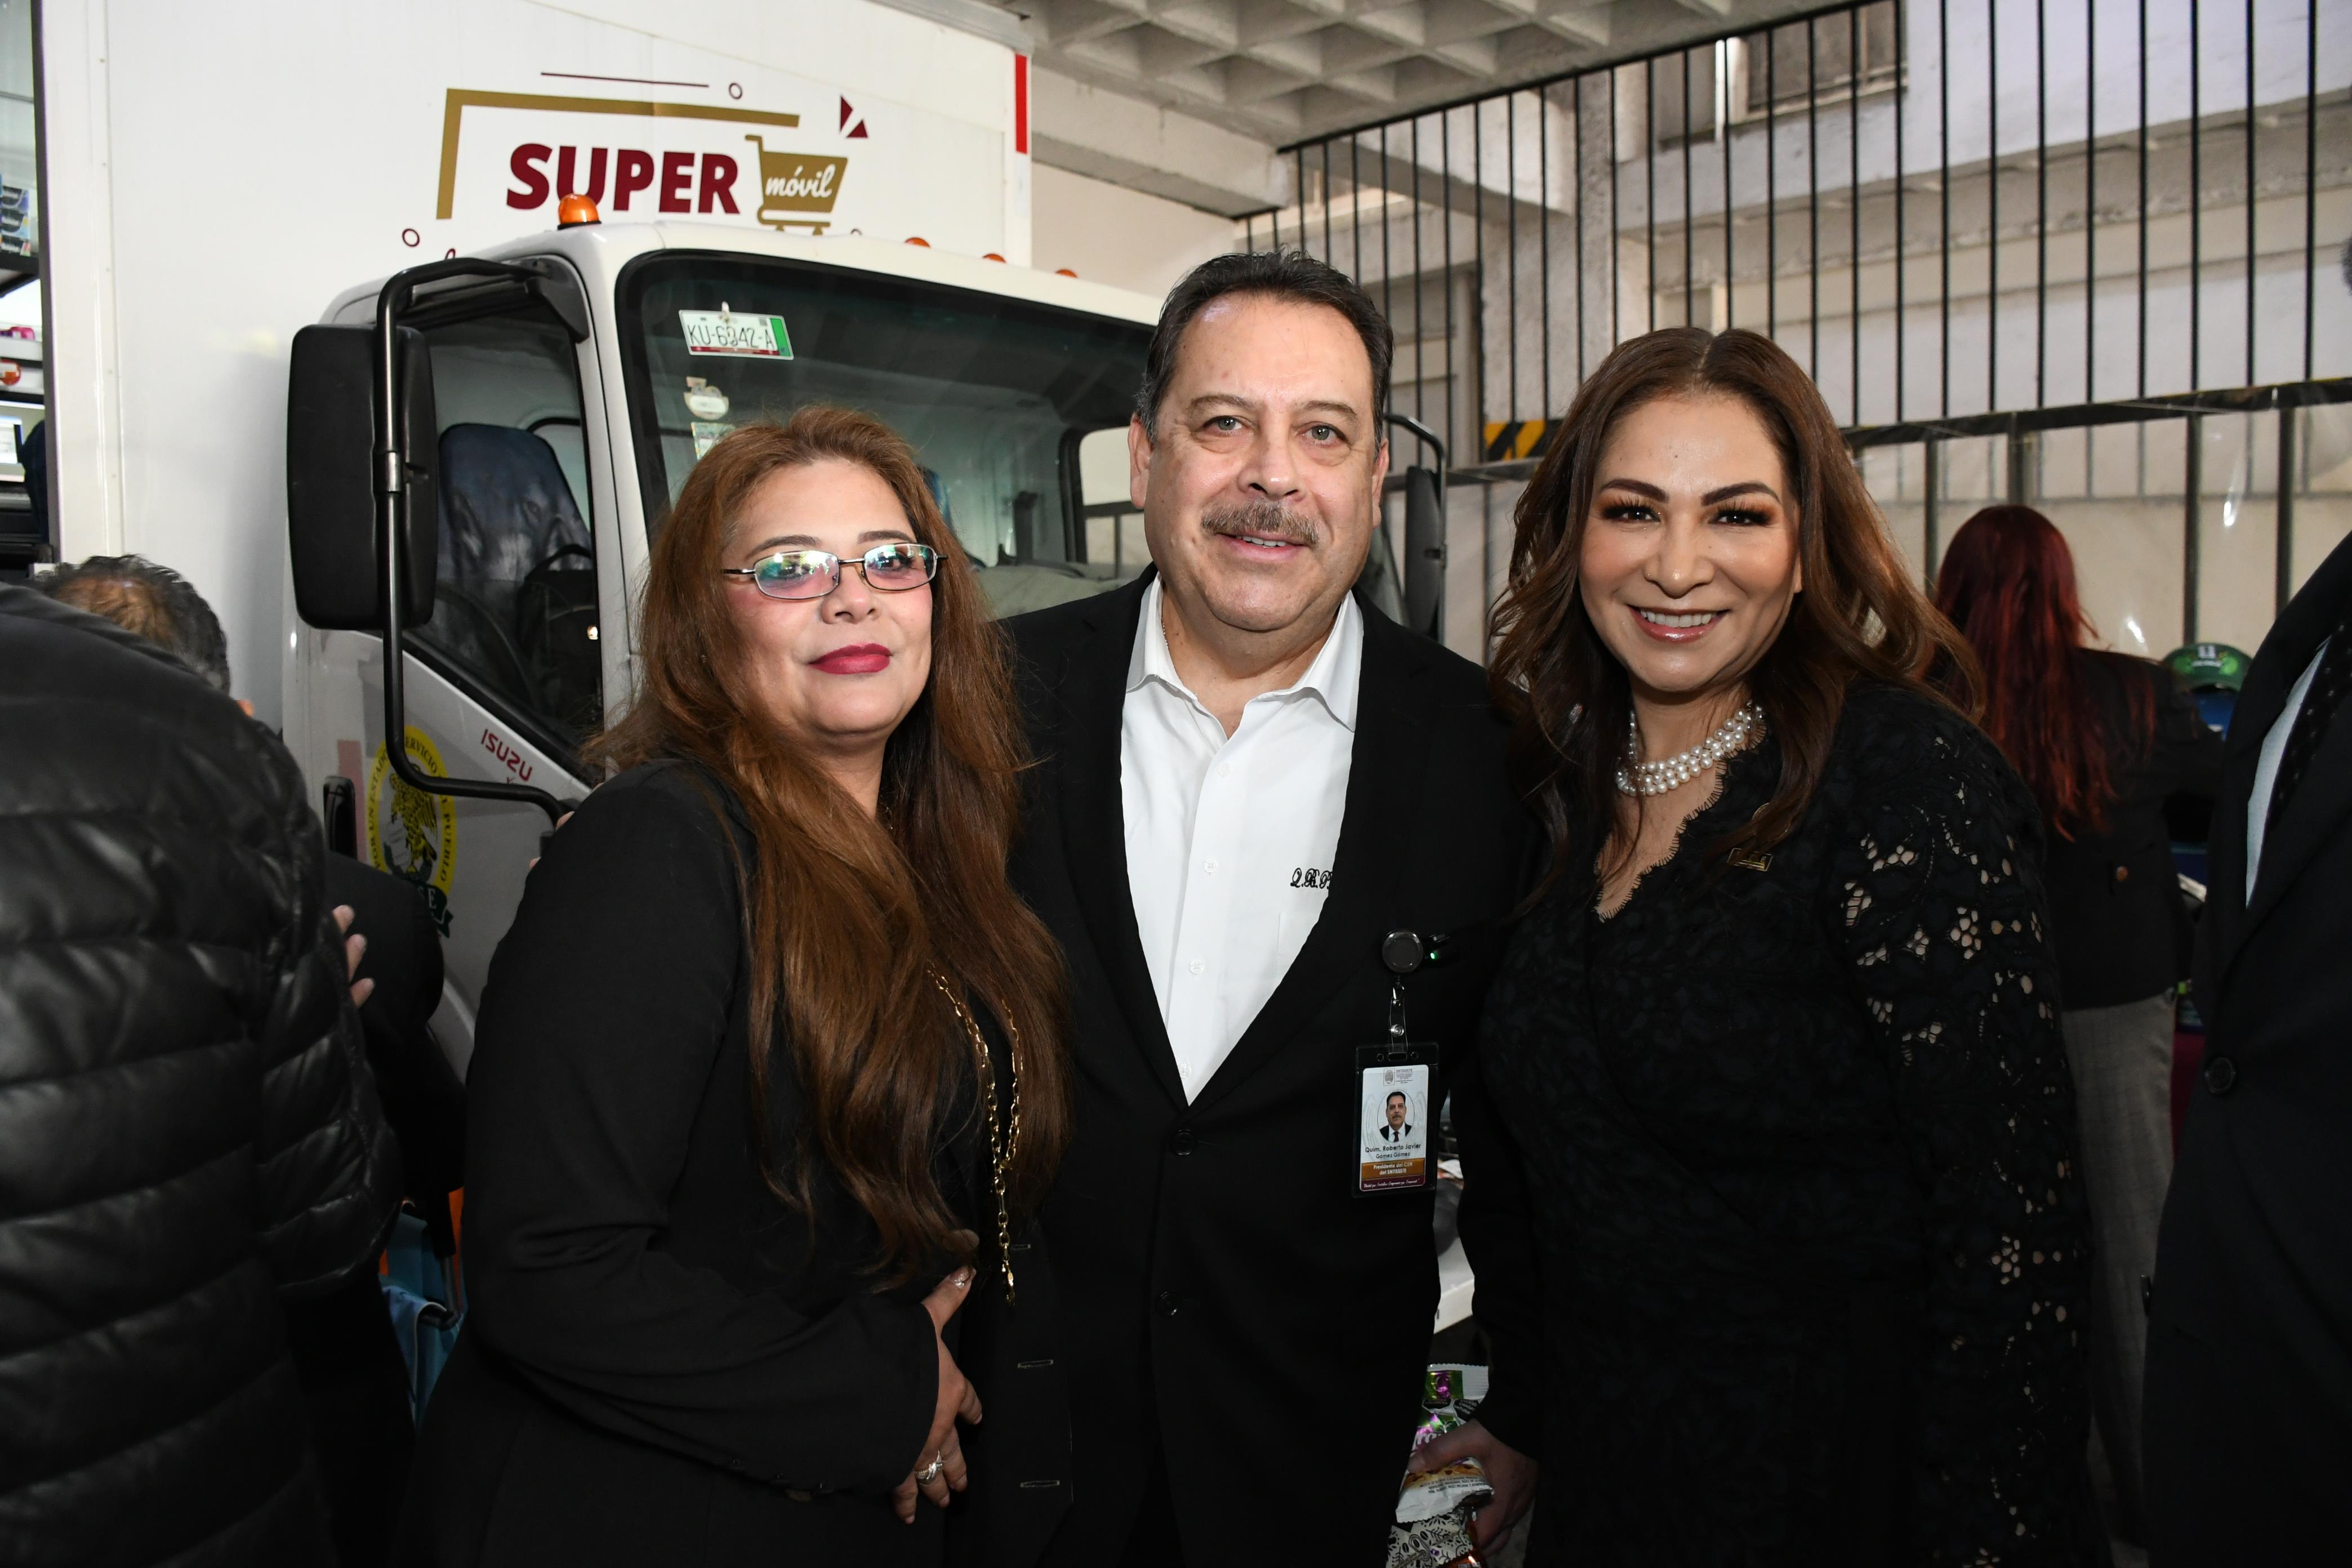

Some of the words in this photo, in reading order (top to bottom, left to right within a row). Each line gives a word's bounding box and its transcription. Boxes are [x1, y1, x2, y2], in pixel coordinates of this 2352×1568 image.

[506, 142, 740, 214] SUPER
[765, 163, 835, 198] móvil
[404, 736, 438, 774] ERVICIO
[480, 729, 533, 781] ISUZU
